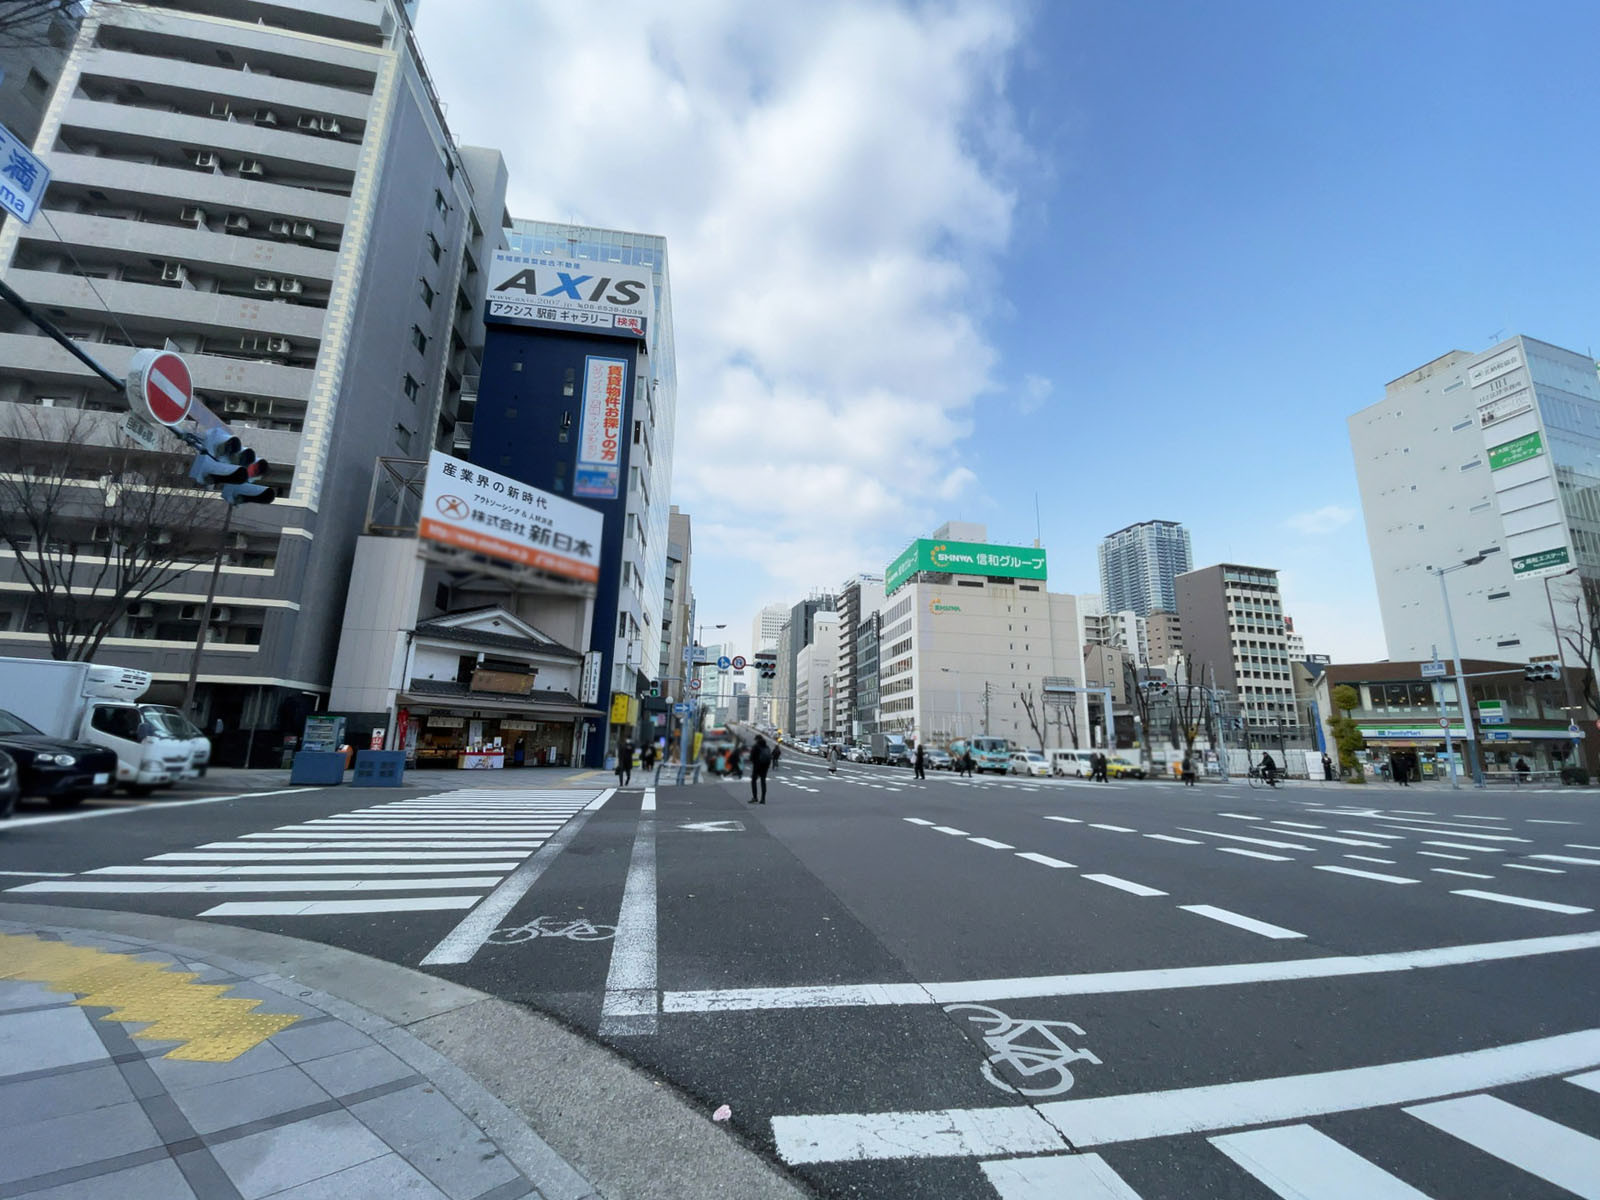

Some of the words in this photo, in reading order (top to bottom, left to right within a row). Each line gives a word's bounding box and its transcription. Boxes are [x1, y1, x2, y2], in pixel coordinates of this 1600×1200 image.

[0, 135, 38, 192] 満
[493, 268, 646, 306] AXIS
[493, 303, 533, 317] アクシス
[536, 307, 557, 320] 駅前
[560, 310, 609, 324] ギャラリー
[616, 316, 639, 328] 検索
[601, 365, 623, 462] 賃貸物件お探しの方
[442, 462, 548, 510] 産業界の新時代
[473, 494, 520, 515] アウトソーシング
[471, 508, 525, 537] 株式会社
[529, 523, 594, 559] 新日本
[938, 553, 973, 564] SHINWA
[976, 553, 1045, 570] 信和グループ
